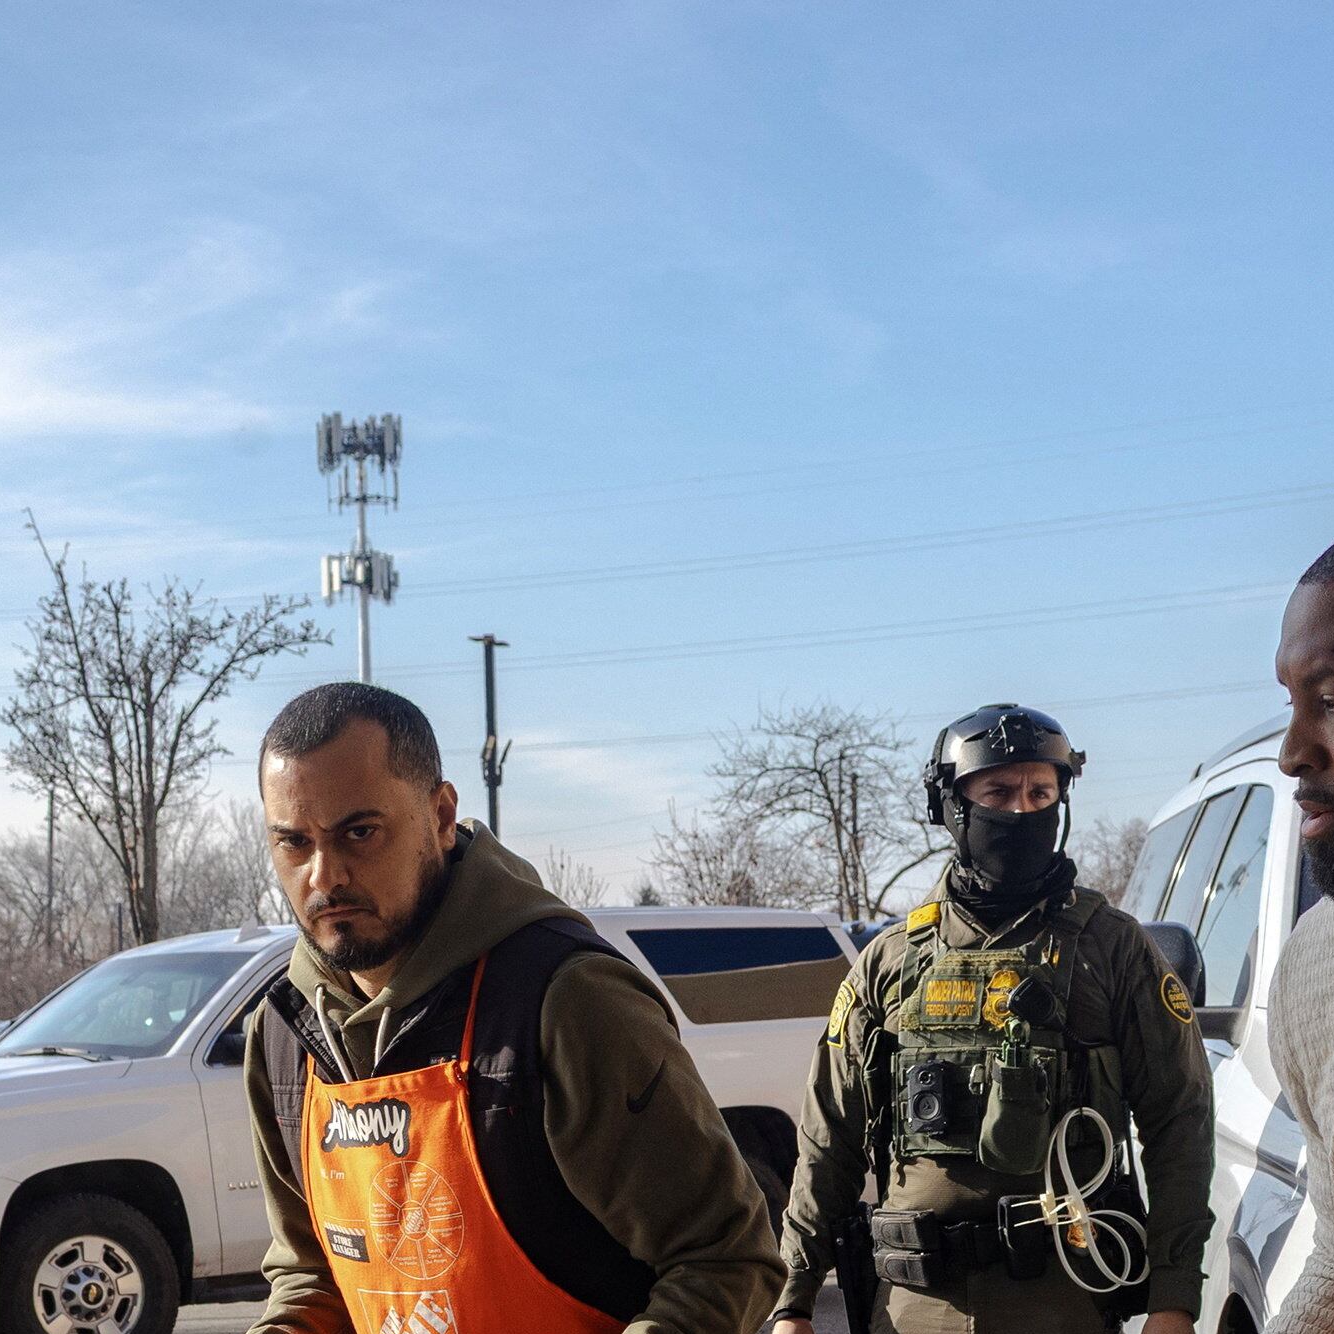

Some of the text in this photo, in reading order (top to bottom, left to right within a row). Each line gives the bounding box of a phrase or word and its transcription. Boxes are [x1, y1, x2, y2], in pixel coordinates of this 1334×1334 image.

[925, 1003, 974, 1017] FEDERAL AGENT
[332, 1233, 354, 1249] STORE
